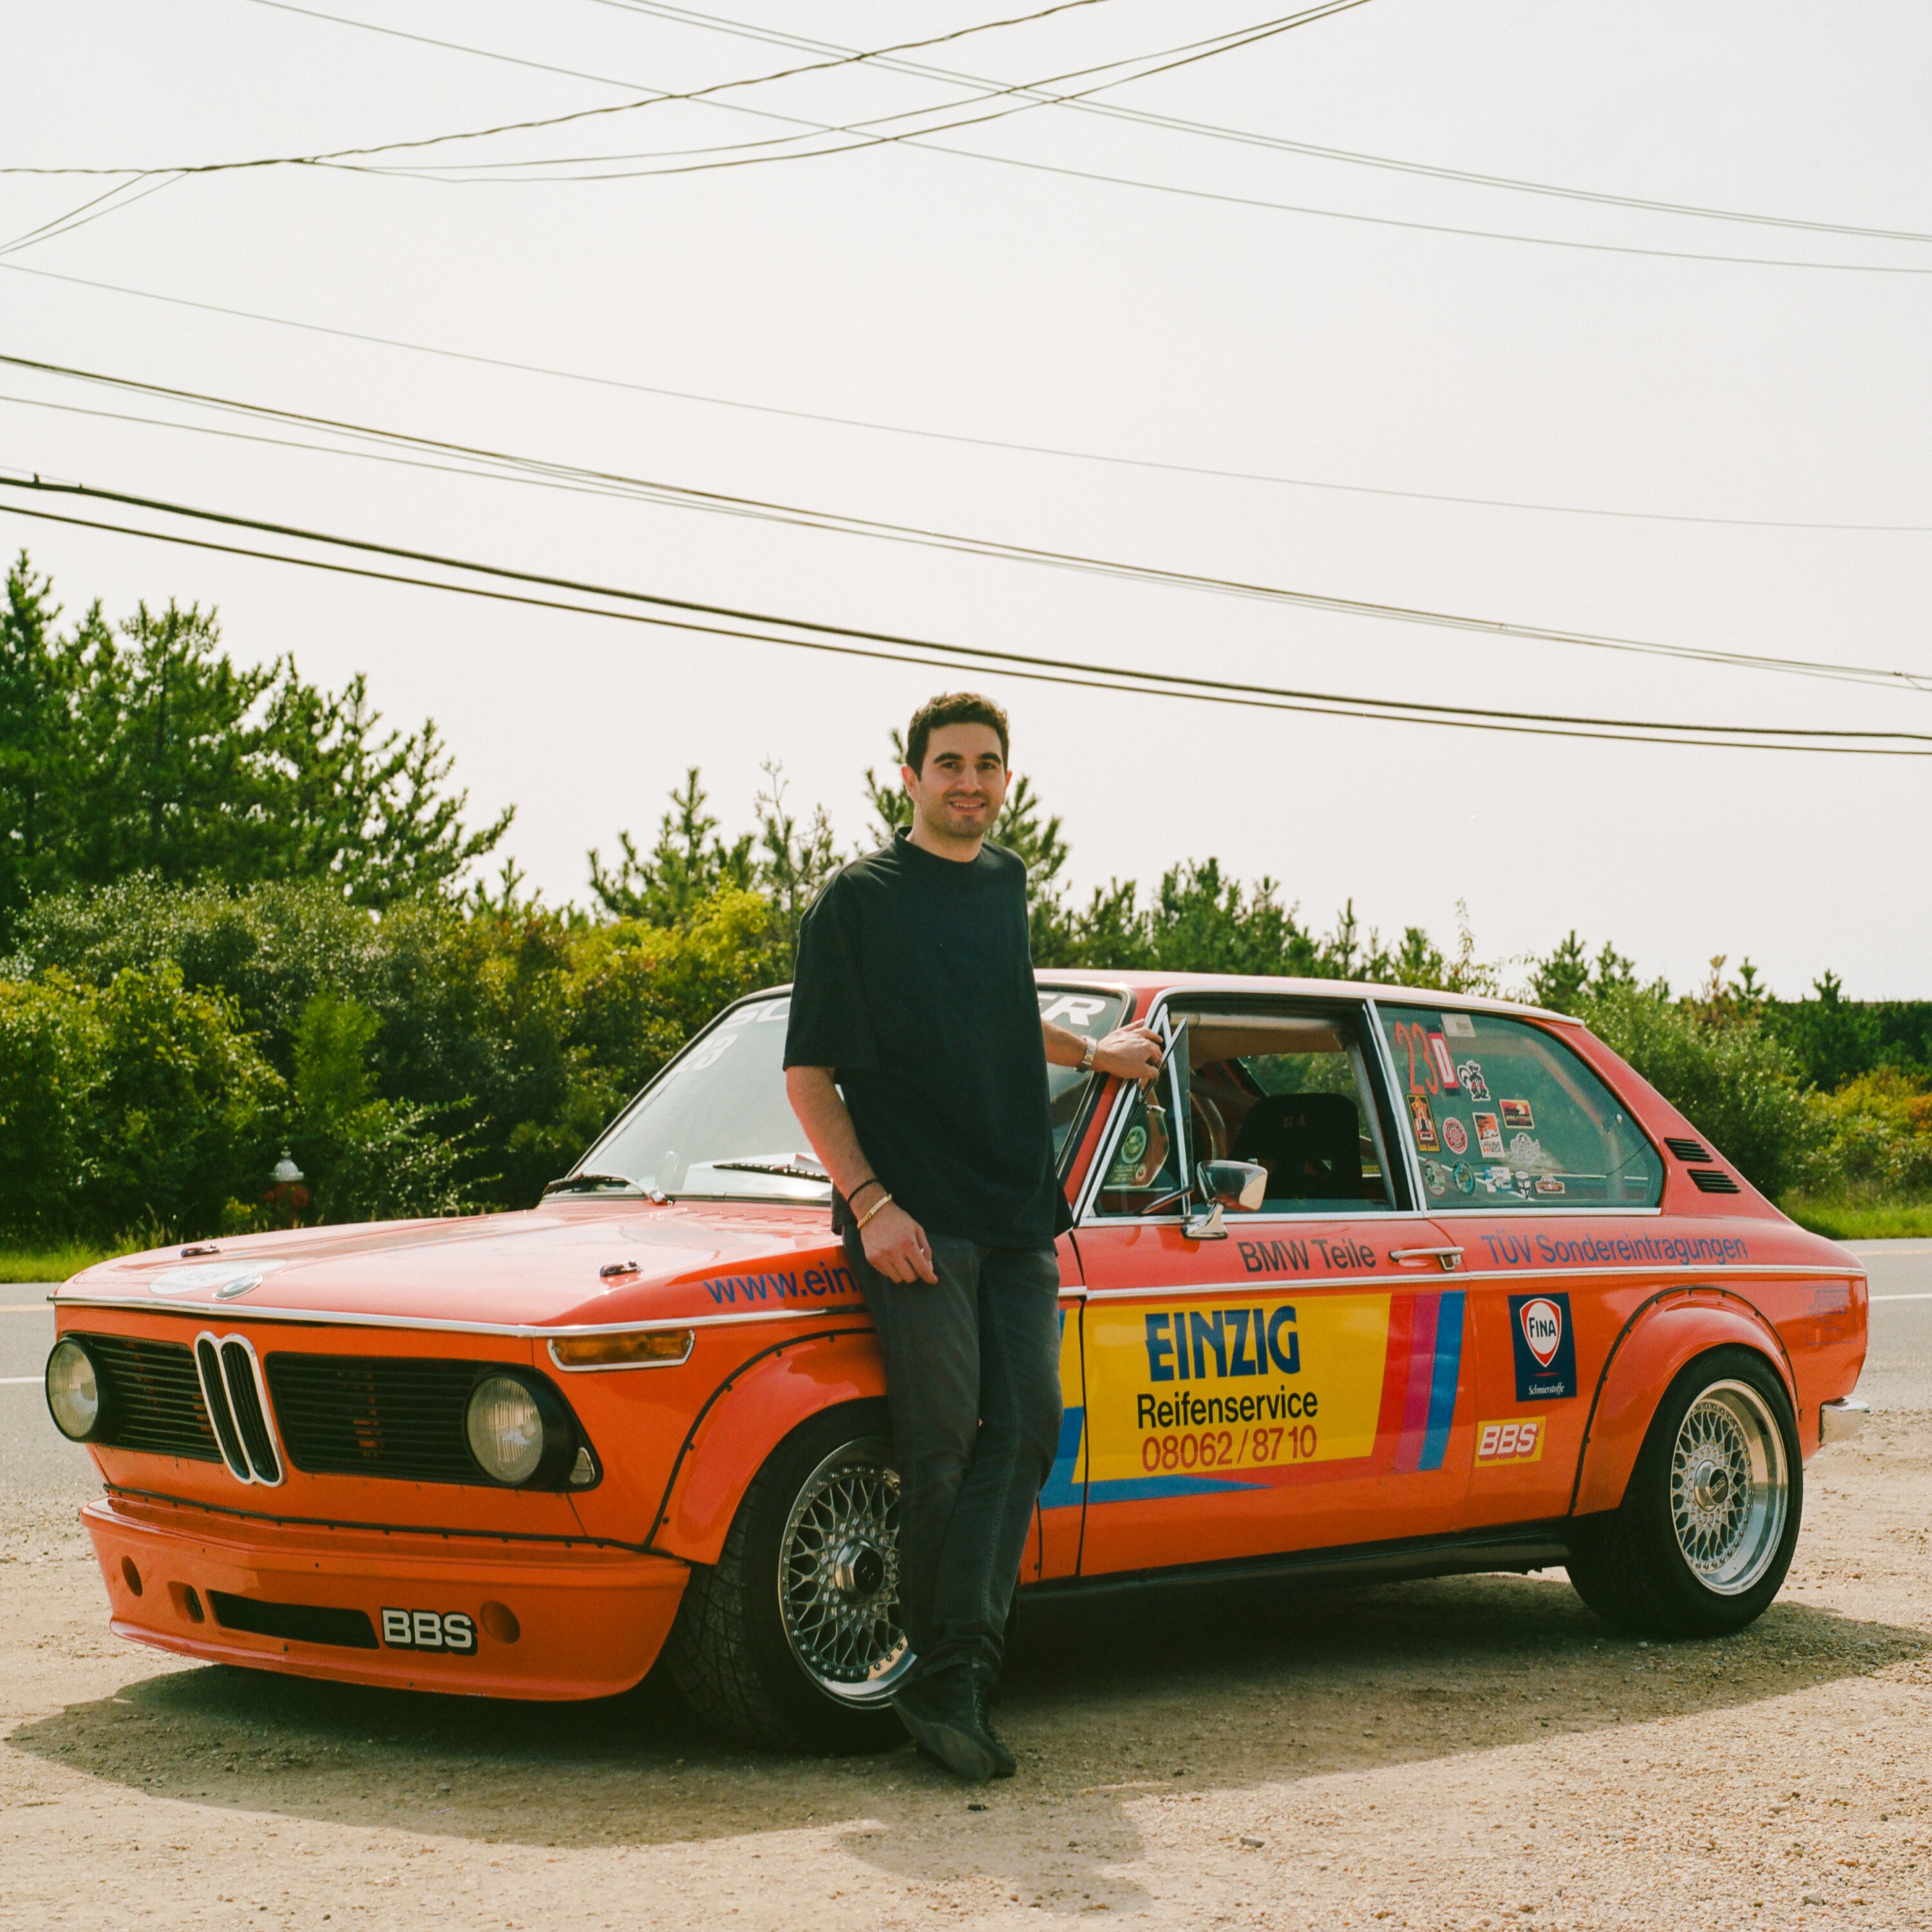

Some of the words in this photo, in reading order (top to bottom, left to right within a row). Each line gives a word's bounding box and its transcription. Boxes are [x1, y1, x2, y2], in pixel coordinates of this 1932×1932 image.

[1394, 1021, 1439, 1096] 23
[1237, 1240, 1311, 1273] BMW
[1311, 1238, 1377, 1270] Teile
[1481, 1229, 1532, 1265] TÜV
[1535, 1232, 1749, 1266] Sondereintragungen
[1145, 1305, 1302, 1382] EINZIG
[1528, 1317, 1557, 1338] FINA
[1137, 1385, 1319, 1429] Reifenservice
[1528, 1382, 1565, 1396] Schmierstoffe
[1478, 1423, 1539, 1458] BBS
[381, 1608, 477, 1653] BBS
